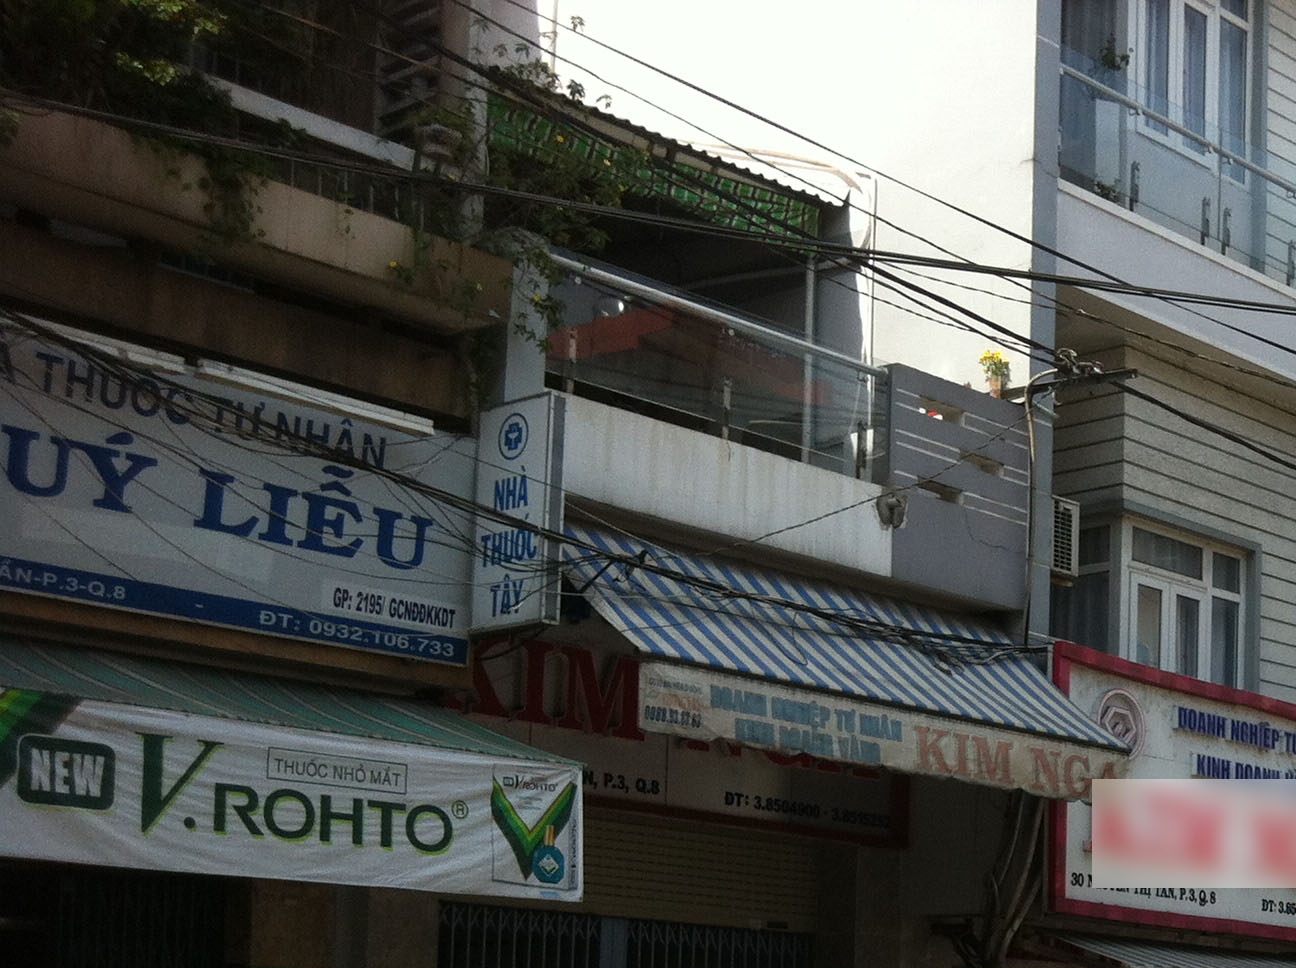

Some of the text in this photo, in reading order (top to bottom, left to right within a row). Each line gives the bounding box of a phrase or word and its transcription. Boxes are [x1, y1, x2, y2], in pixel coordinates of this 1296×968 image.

[494, 465, 528, 512] NHÀ
[193, 465, 434, 569] LIỄU
[481, 513, 537, 568] THUỐC
[490, 574, 524, 618] TÂY
[259, 610, 455, 657] ĐT: 0932.106.733
[1178, 706, 1226, 739] DOANH
[30, 747, 105, 799] NEW
[274, 756, 402, 788] THUỐC NHỎ MẮT
[914, 725, 1014, 785] KIM
[1197, 754, 1232, 780] KINH
[1071, 872, 1085, 888] 30
